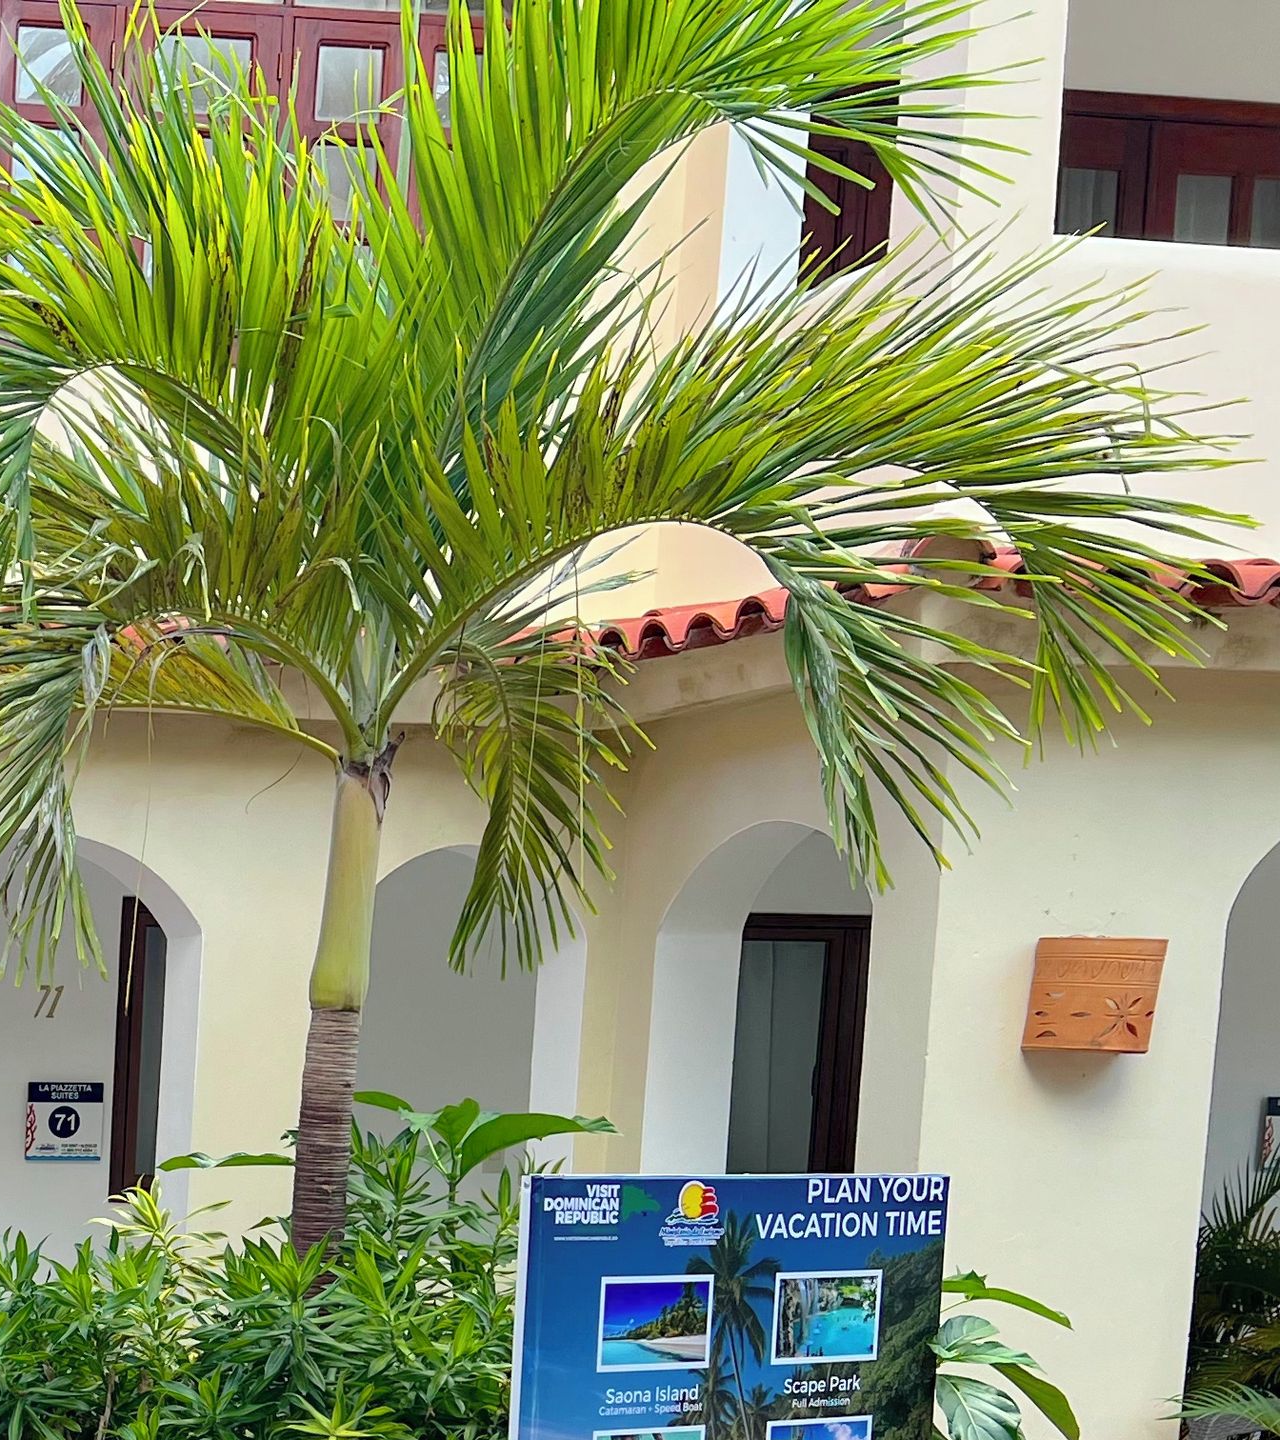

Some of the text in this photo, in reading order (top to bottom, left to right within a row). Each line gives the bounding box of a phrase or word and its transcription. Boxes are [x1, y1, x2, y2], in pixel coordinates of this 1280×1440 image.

[34, 985, 64, 1018] 71
[51, 1092, 79, 1100] SUITES
[54, 1113, 76, 1131] 71
[586, 1185, 620, 1198] VISIT
[807, 1178, 945, 1204] PLAN YOUR
[543, 1198, 619, 1212] DOMINICAN
[555, 1211, 619, 1225] REPUBLIC
[755, 1210, 942, 1239] VACATION TIME
[783, 1374, 861, 1396] Scape Park
[605, 1383, 699, 1404] Saona Island
[599, 1405, 646, 1416] Catamaran
[654, 1403, 681, 1415] Speed
[683, 1401, 703, 1412] Boat
[792, 1396, 851, 1408] Full Admission
